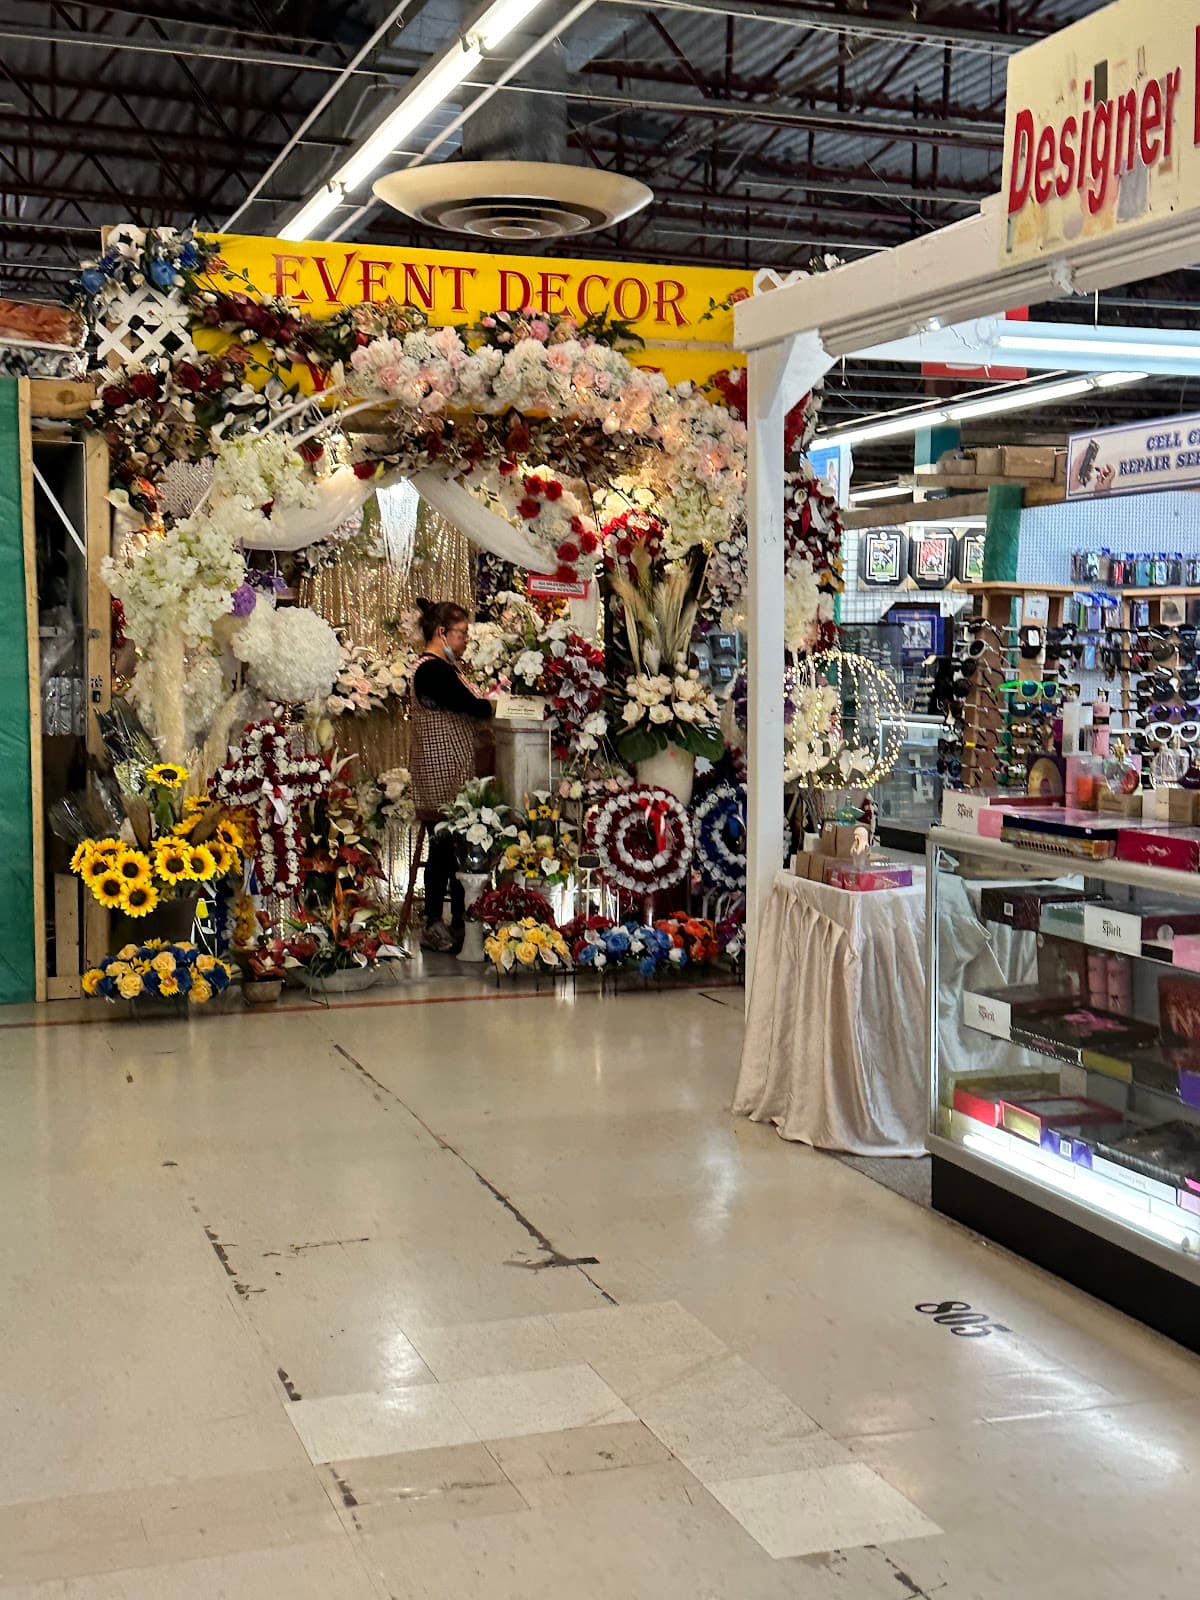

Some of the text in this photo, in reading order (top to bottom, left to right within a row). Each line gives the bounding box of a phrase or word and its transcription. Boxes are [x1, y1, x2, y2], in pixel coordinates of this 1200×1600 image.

[1008, 65, 1181, 215] Designer
[270, 251, 692, 328] EVENT DECOR
[1146, 428, 1200, 451] CELL C
[1119, 455, 1171, 476] REPAIR
[914, 1300, 1014, 1337] 805
